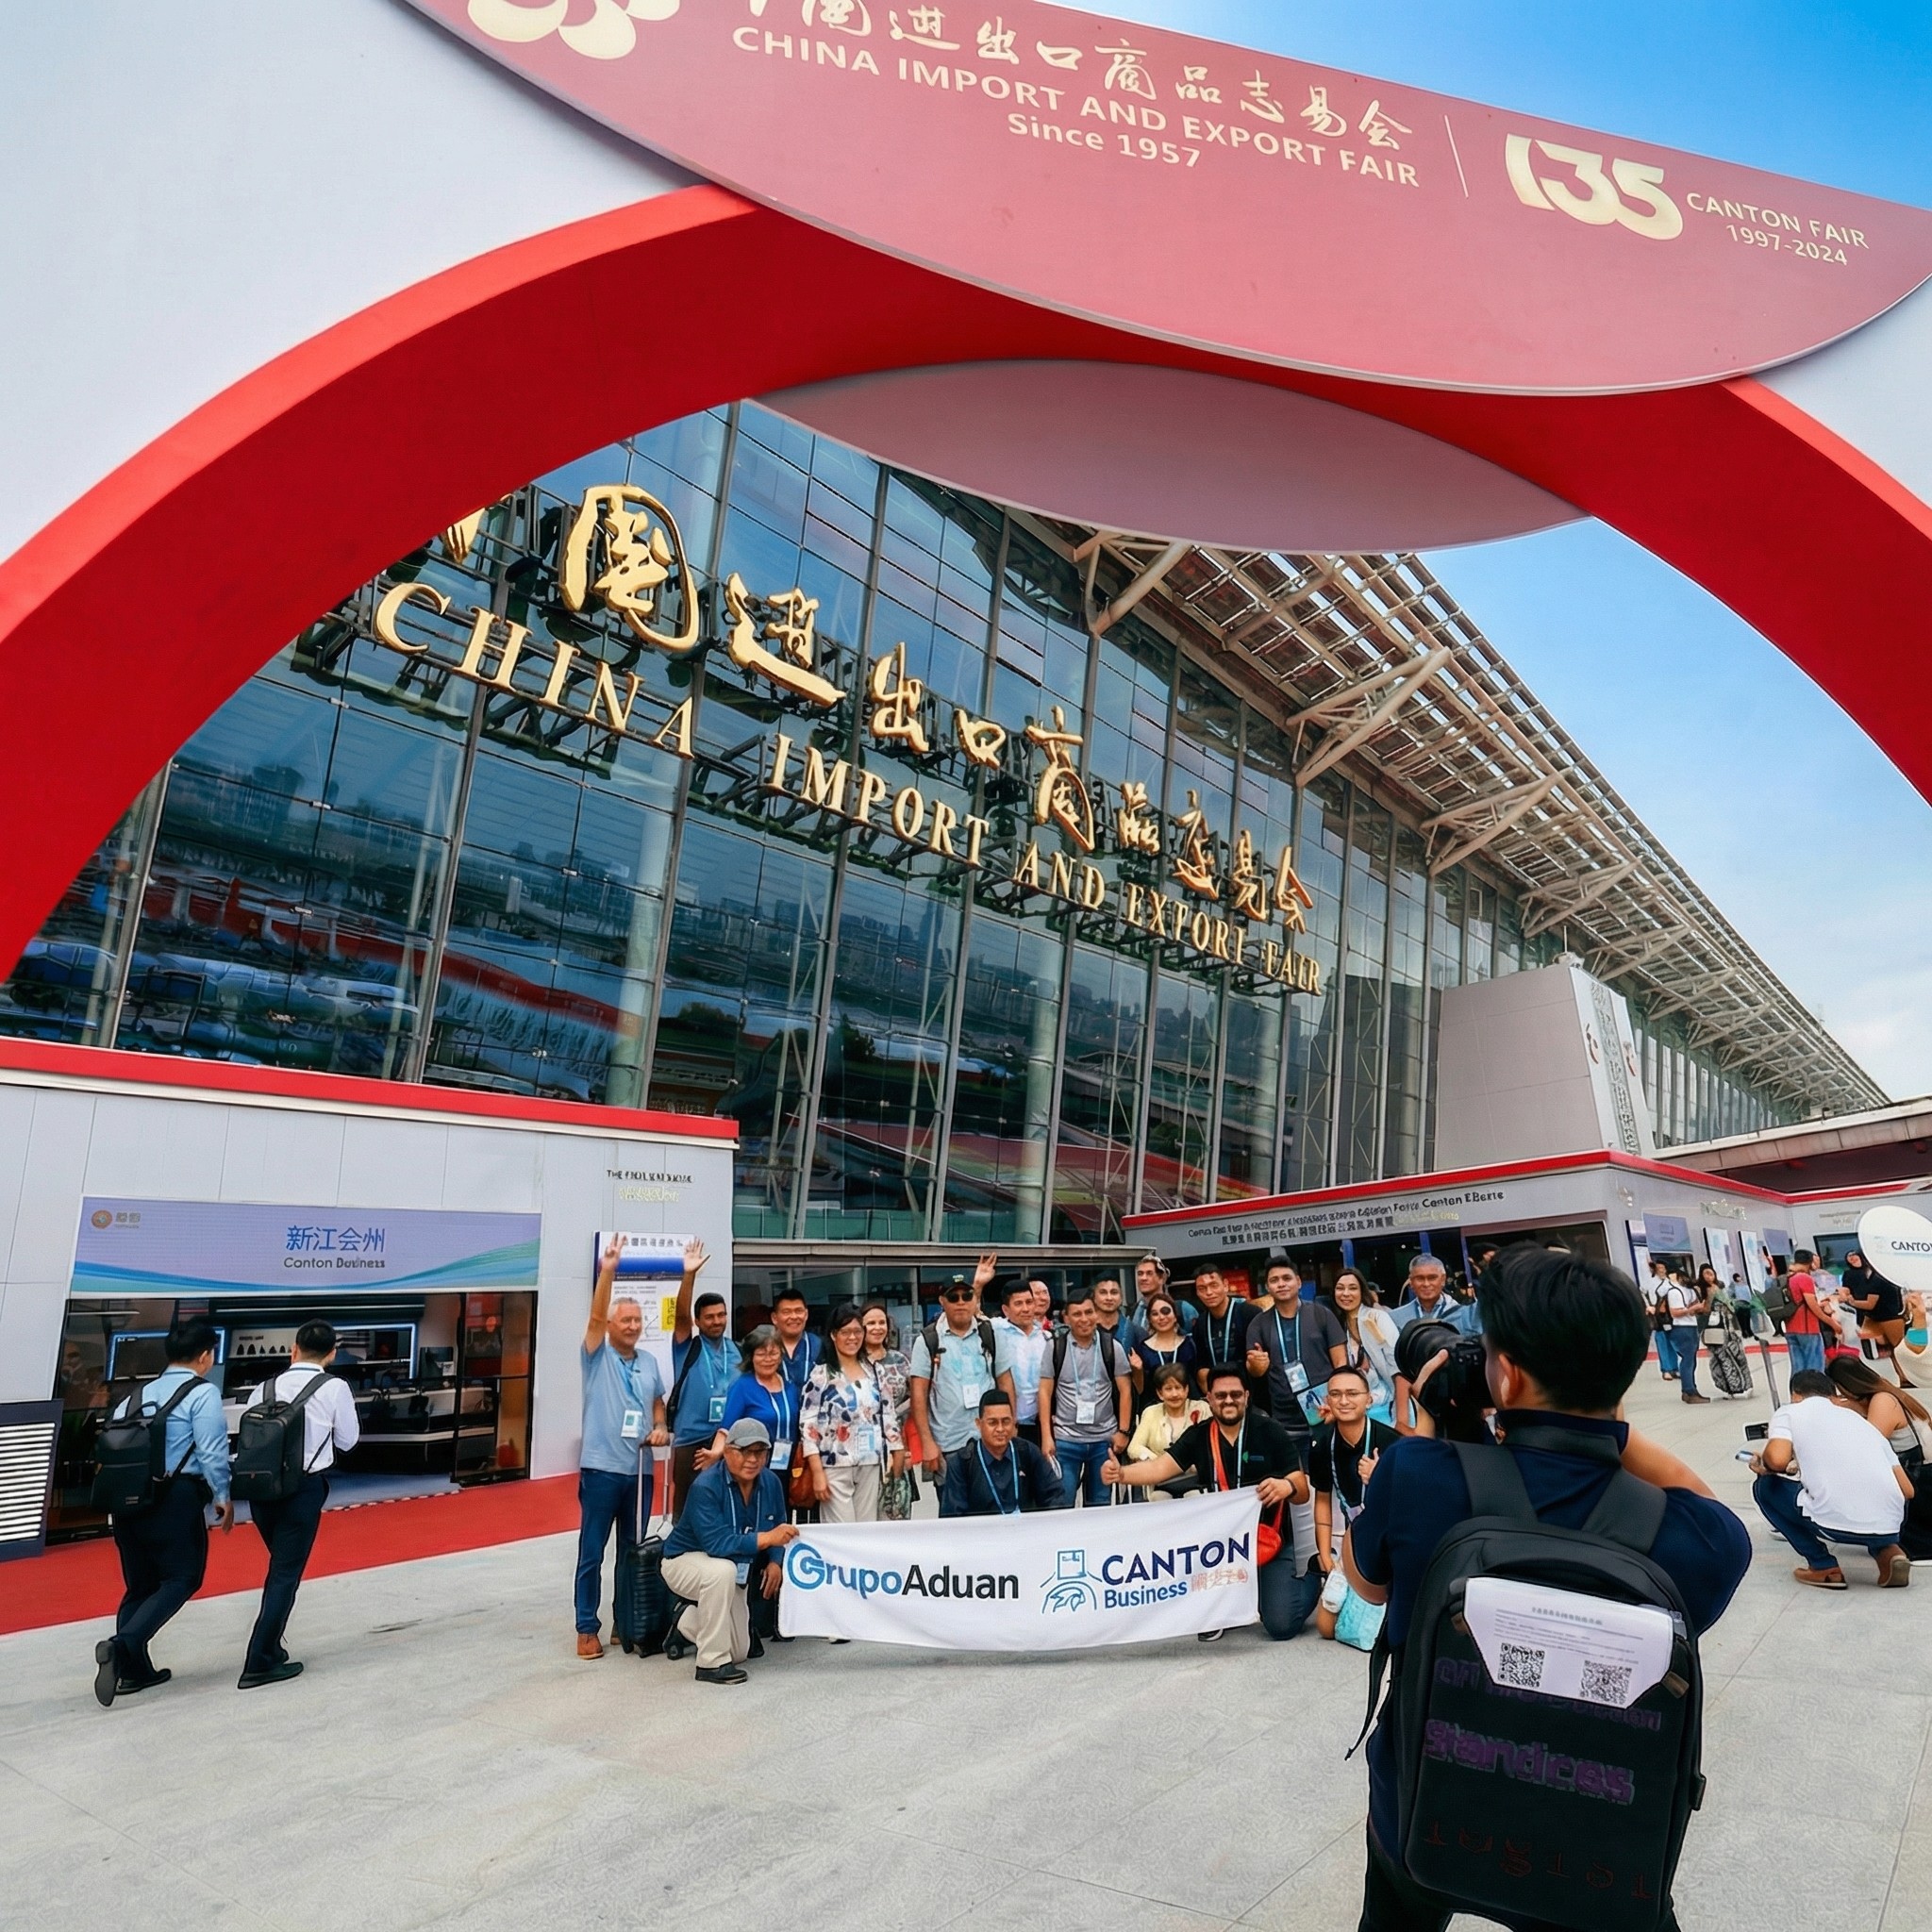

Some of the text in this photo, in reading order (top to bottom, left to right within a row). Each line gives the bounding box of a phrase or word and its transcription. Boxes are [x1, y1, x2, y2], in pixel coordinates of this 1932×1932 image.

[732, 26, 880, 75] CHINA
[899, 58, 1065, 110] IMPORT
[1080, 96, 1167, 131] AND
[1183, 115, 1325, 166] EXPORT
[1340, 149, 1419, 187] FAIR
[1008, 113, 1201, 168] Since 1957
[1505, 133, 1684, 241] 135
[1686, 192, 1870, 250] CANTON FAIR
[1725, 224, 1848, 266] 1997-2024
[374, 582, 696, 759] CHINA
[767, 734, 991, 867] IMPORT
[1012, 841, 1106, 911] AND
[1262, 940, 1322, 996] FAIR
[286, 1225, 385, 1253] 新江会州
[1890, 1241, 1932, 1253] CANTO
[787, 1542, 1019, 1599] GrupoAduan
[1101, 1532, 1250, 1585] CANTON
[1105, 1581, 1188, 1609] Business
